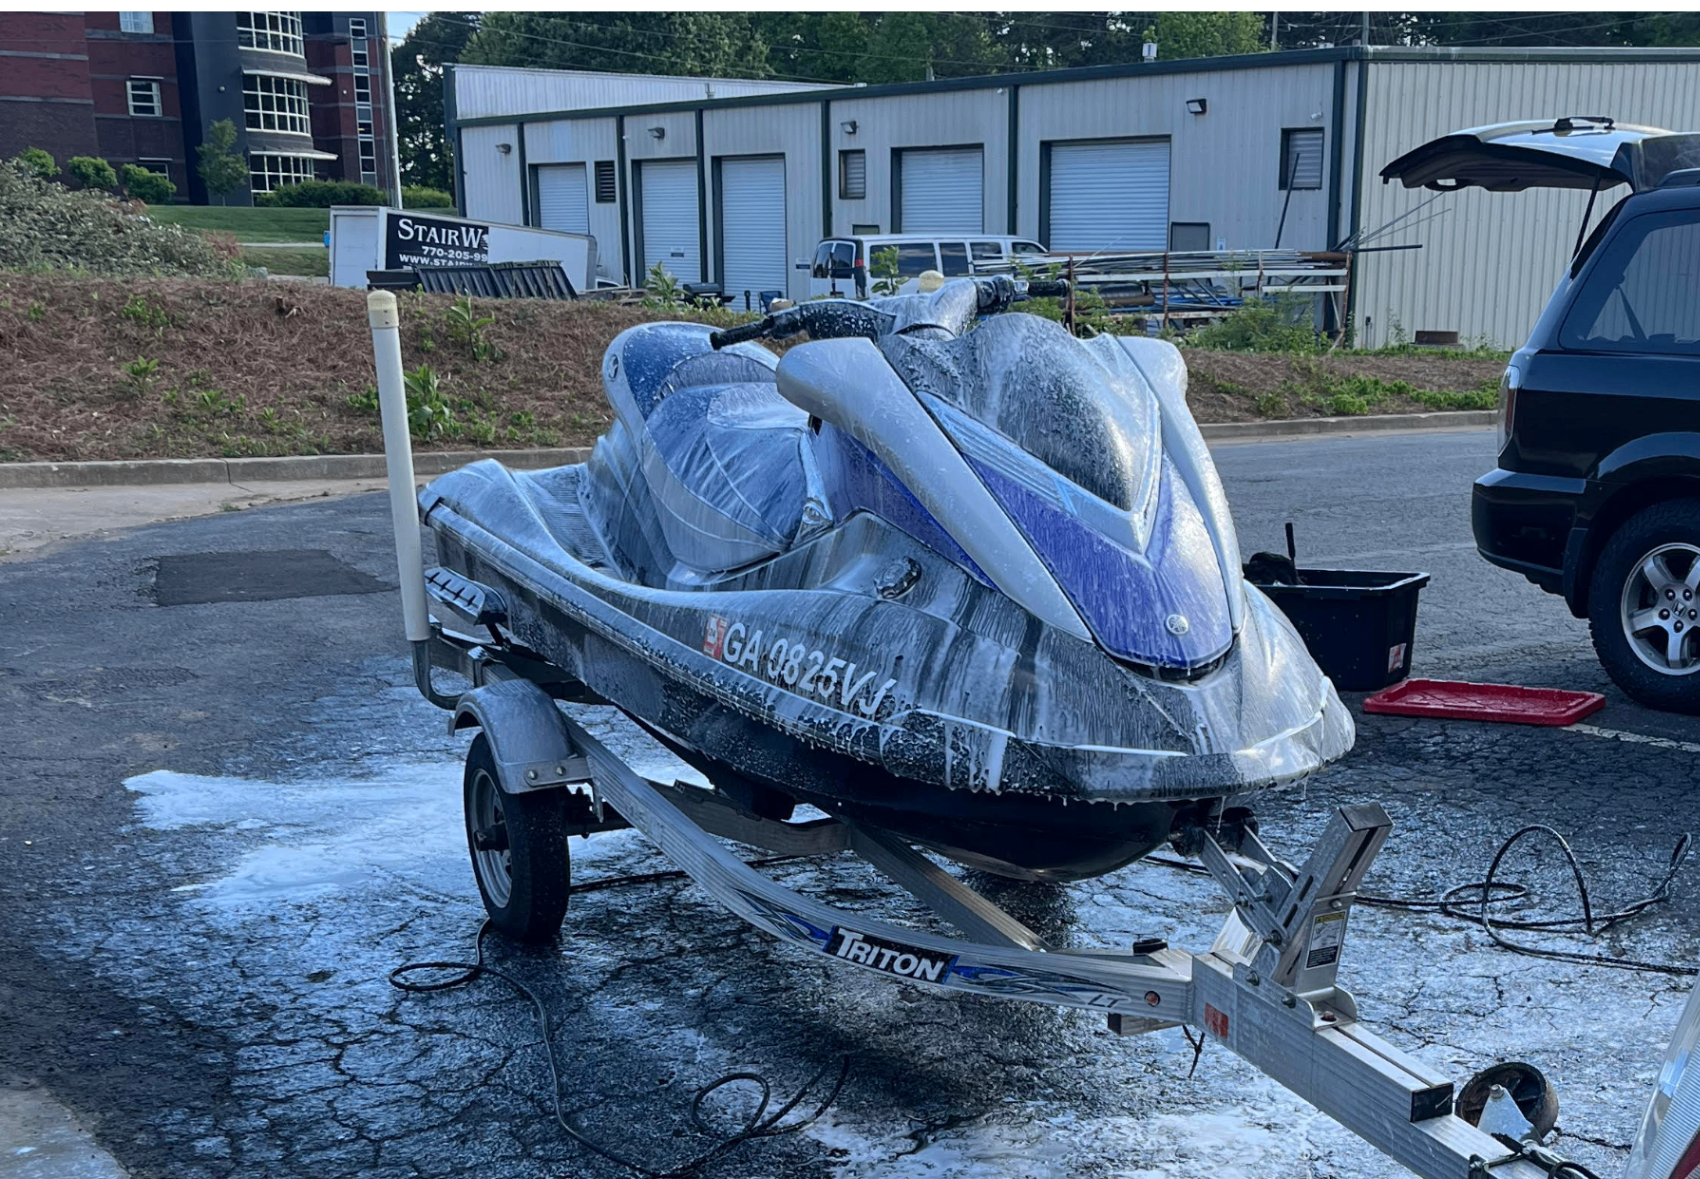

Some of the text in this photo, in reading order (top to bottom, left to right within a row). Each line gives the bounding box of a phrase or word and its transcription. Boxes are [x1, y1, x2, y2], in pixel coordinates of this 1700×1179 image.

[398, 218, 488, 249] STAIRW
[723, 622, 762, 671] GA
[767, 638, 846, 698] 0825
[836, 927, 944, 981] TRITON
[1088, 994, 1128, 1008] LT
